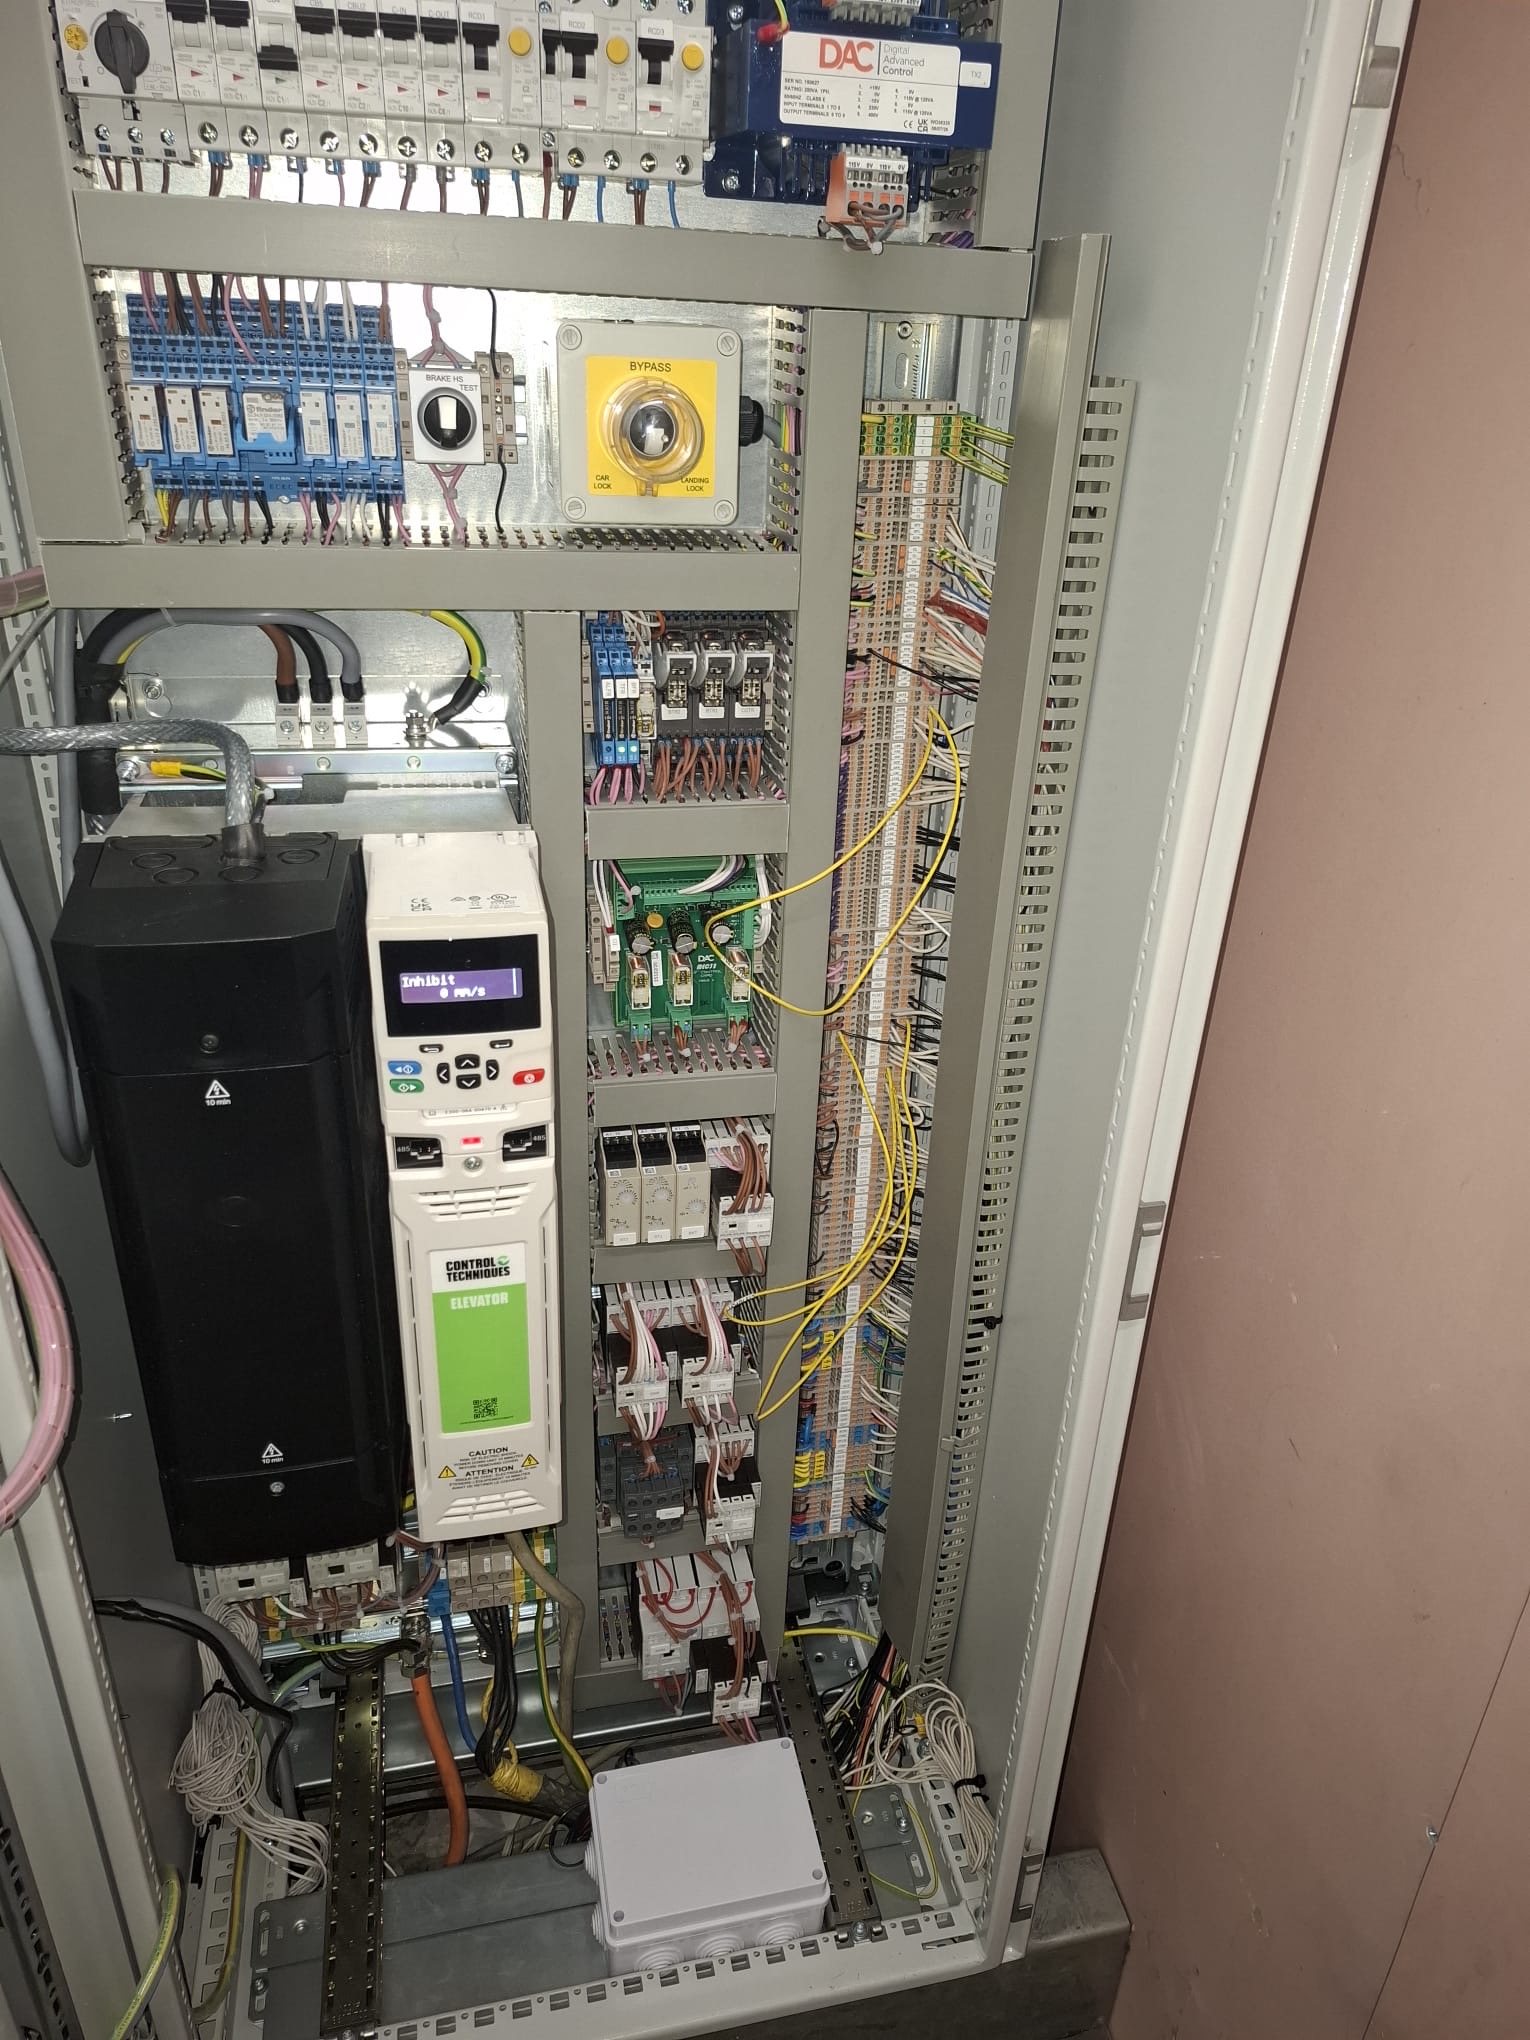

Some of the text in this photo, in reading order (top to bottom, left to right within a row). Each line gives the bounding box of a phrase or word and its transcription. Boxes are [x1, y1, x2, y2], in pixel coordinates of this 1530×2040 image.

[468, 12, 486, 21] RCD1
[648, 27, 665, 36] RCD3
[883, 44, 910, 54] Digital
[819, 38, 875, 72] DAC
[882, 56, 925, 67] Advanced
[882, 66, 914, 76] Control
[630, 362, 672, 372] BYPASS
[426, 374, 452, 382] BRAKE
[460, 384, 478, 392] TEST
[698, 954, 714, 962] DAC
[402, 974, 456, 988] Inhibit
[440, 988, 449, 998] 0
[216, 1098, 232, 1106] min
[446, 1256, 496, 1272] CONTROL
[446, 1266, 510, 1282] TECHNIQUES
[450, 1292, 509, 1310] ELEVATOR
[468, 1446, 508, 1457] CAUTION
[465, 1464, 514, 1477] ATTENTION
